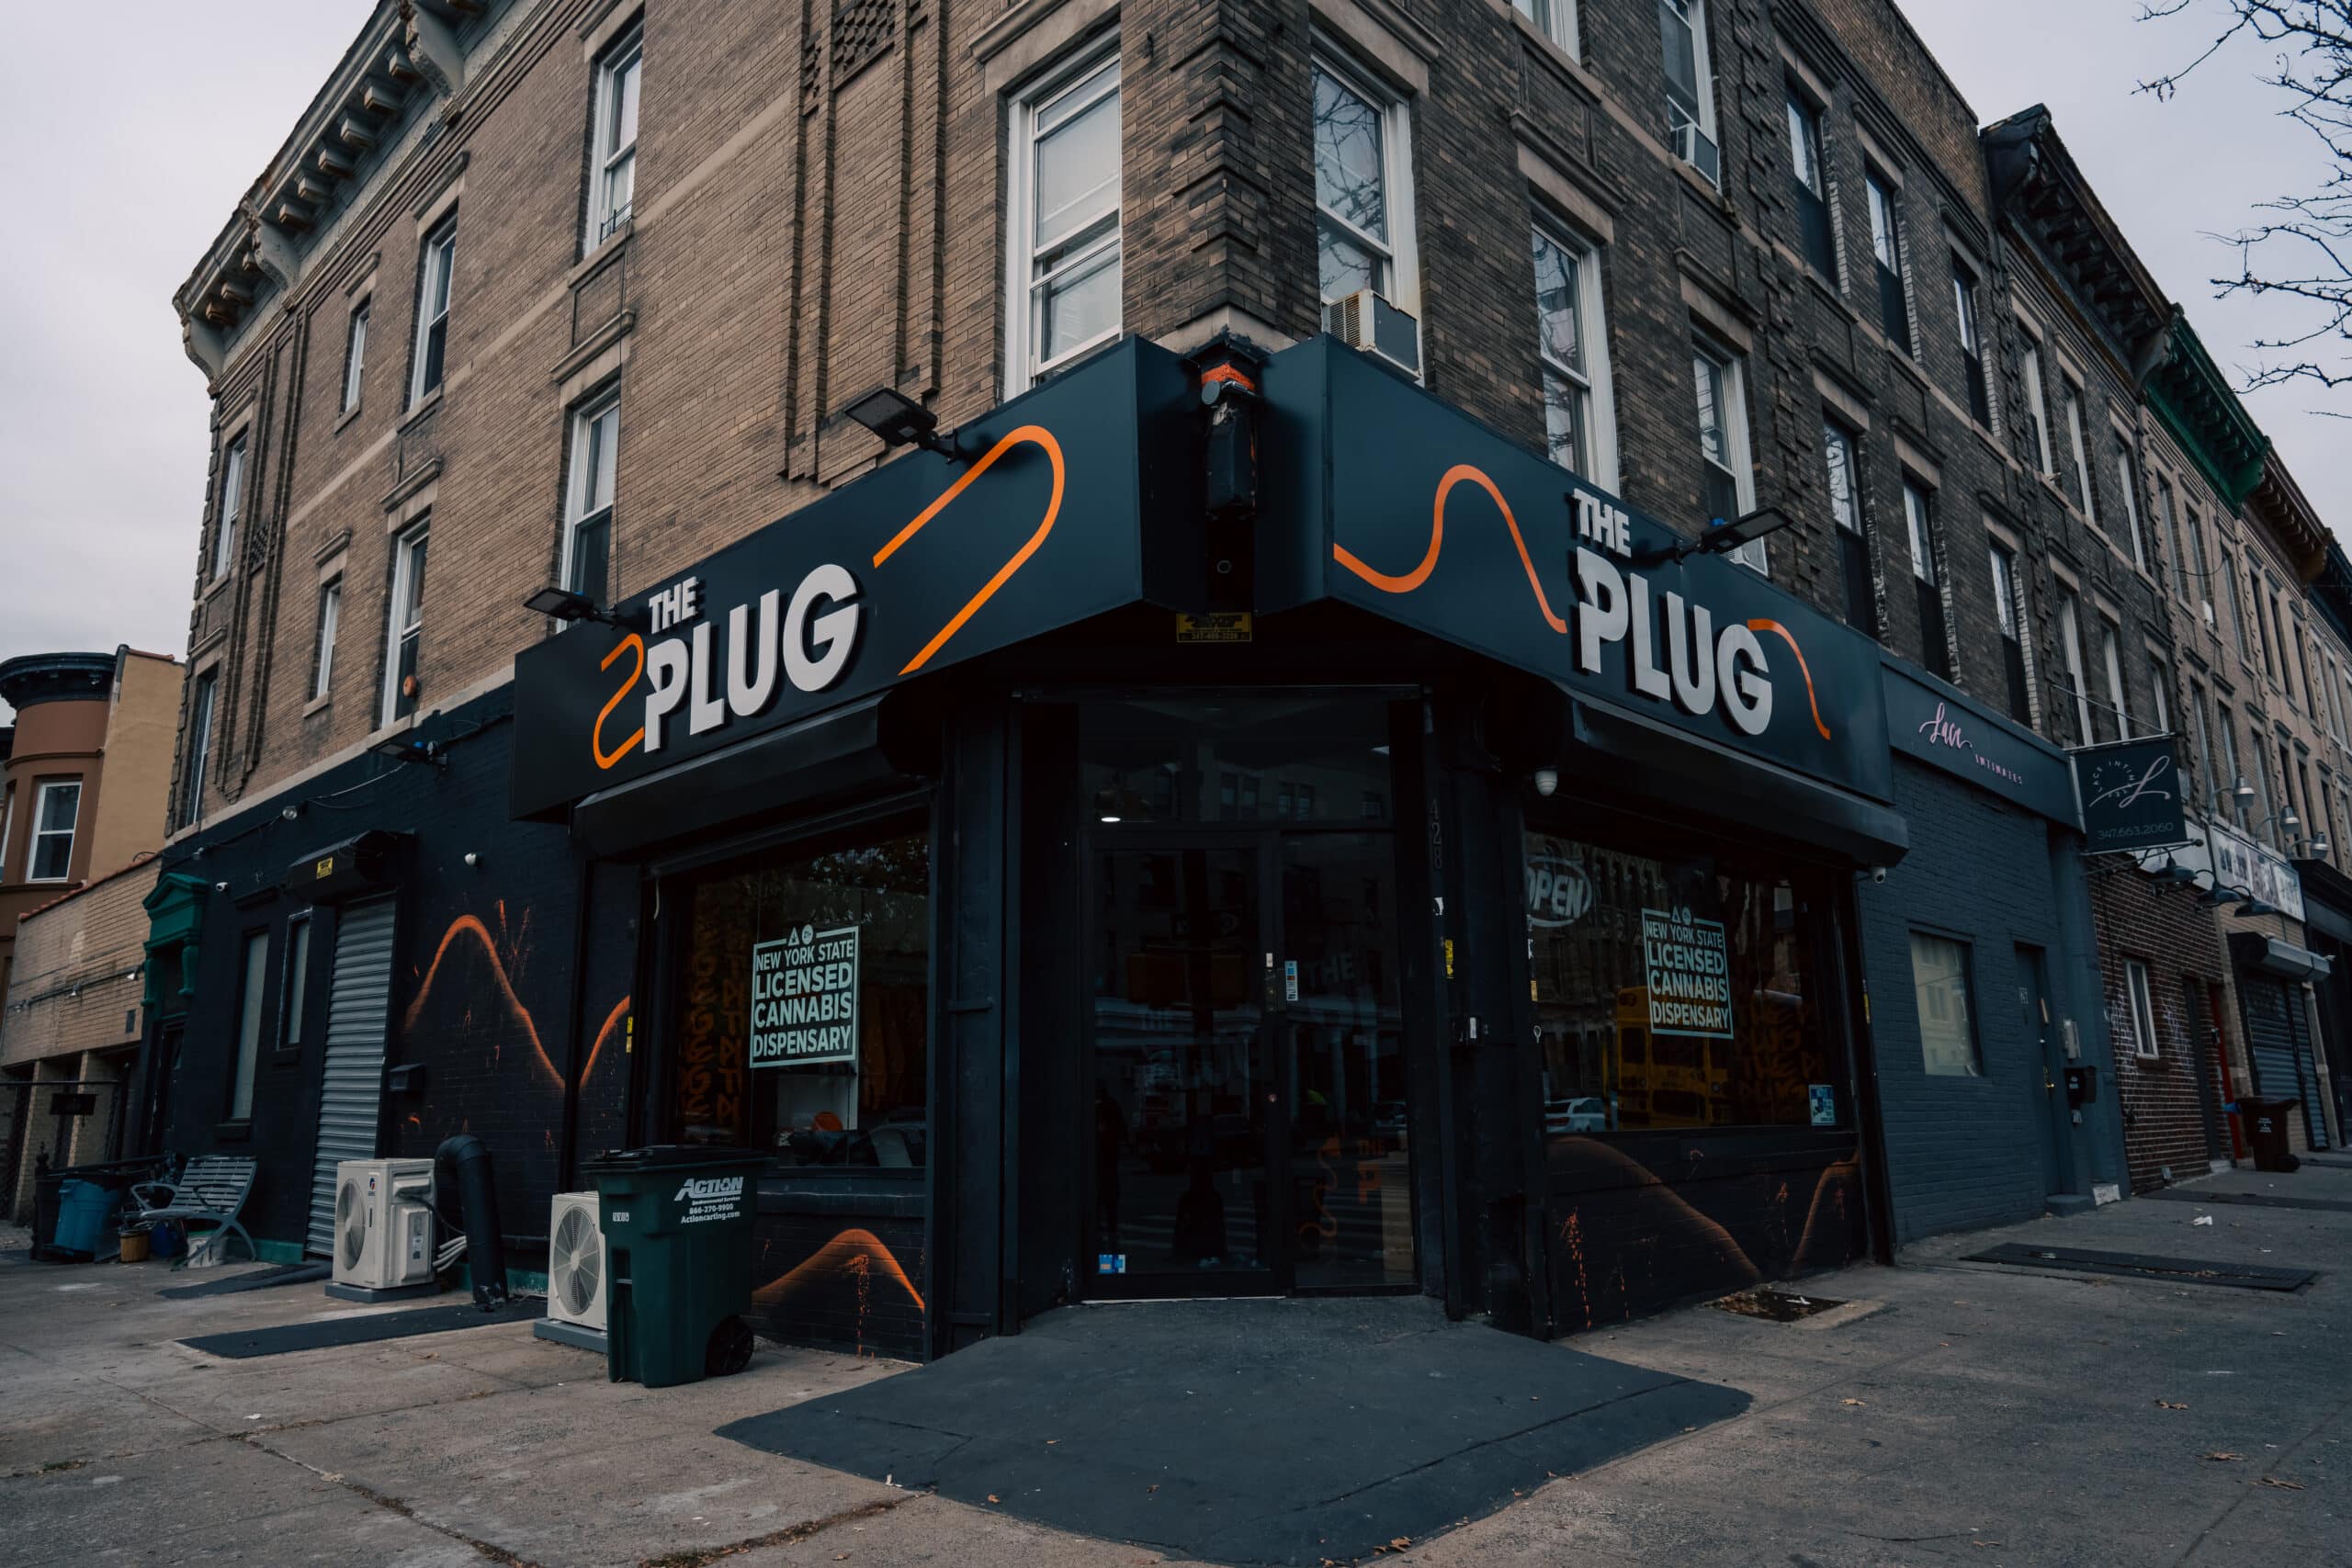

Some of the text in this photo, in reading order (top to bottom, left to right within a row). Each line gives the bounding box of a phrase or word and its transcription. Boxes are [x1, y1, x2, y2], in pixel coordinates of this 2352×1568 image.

[1573, 487, 1632, 558] THE
[649, 576, 698, 633] THE
[644, 563, 859, 753] PLUG
[1576, 546, 1773, 736] PLUG
[1645, 919, 1724, 949] NEW YORK STATE
[756, 939, 854, 971] NEW YORK STATE
[1647, 941, 1725, 976] LICENSED
[755, 962, 853, 1000] LICENSED
[1650, 969, 1728, 1003] CANNABIS
[754, 991, 853, 1028] CANNABIS
[1652, 1000, 1730, 1030] DISPENSARY
[752, 1024, 852, 1057] DISPENSARY
[673, 1176, 743, 1201] ACTION
